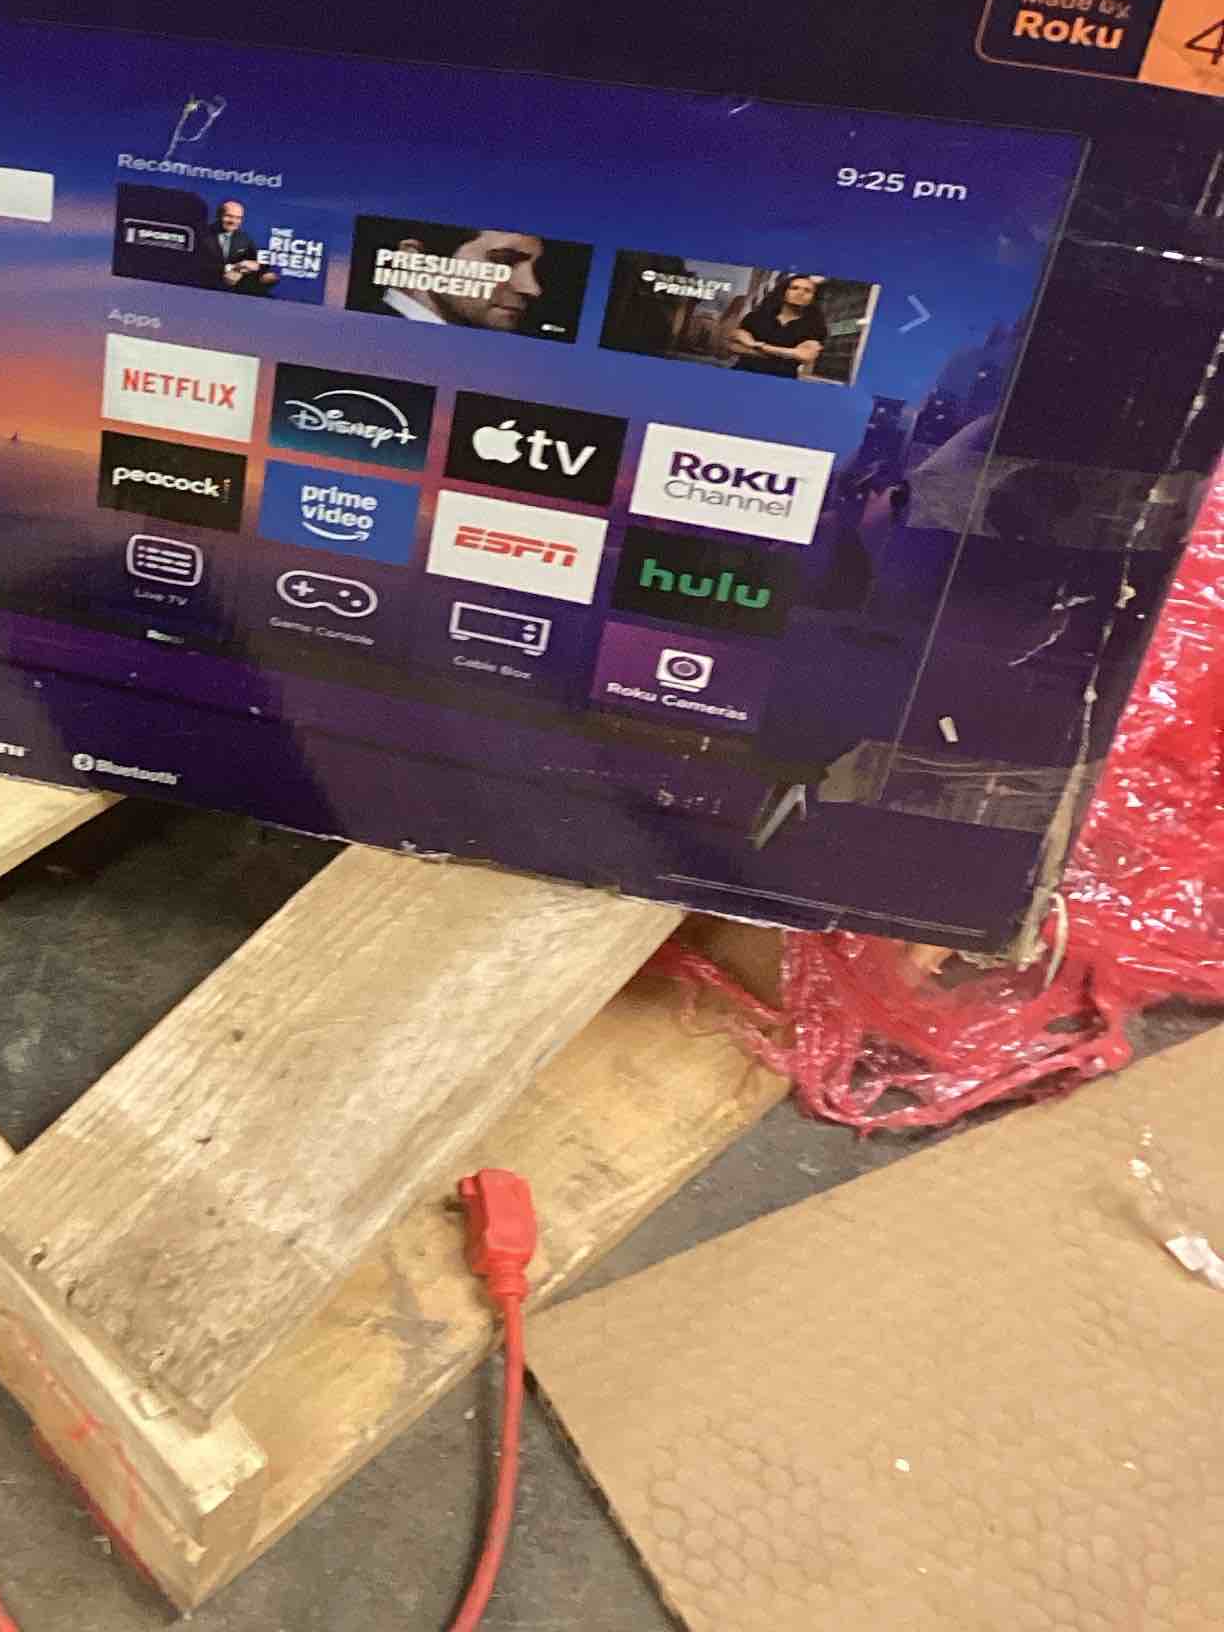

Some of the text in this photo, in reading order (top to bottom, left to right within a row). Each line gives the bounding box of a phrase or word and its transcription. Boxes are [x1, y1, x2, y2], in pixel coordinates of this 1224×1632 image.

[1013, 9, 1124, 49] Roku
[116, 153, 283, 189] Recommended
[836, 166, 969, 201] 9:25 pm
[137, 228, 187, 245] SPORTS
[269, 236, 324, 258] RICH
[256, 249, 322, 273] EISEN
[376, 248, 514, 284] PRESUMED
[373, 268, 499, 301] INNOCENT
[653, 280, 717, 301] PRIME
[108, 308, 162, 329] Apps
[121, 367, 238, 410] NETFLIX
[527, 428, 599, 477] tv
[111, 465, 222, 498] peacock
[668, 450, 798, 497] Roku
[300, 483, 378, 512] prime
[663, 479, 794, 520] Channel
[300, 503, 376, 531] video
[454, 524, 578, 568] ESPN
[639, 558, 772, 610] hulu
[315, 625, 376, 647] Console
[452, 654, 498, 675] Cable
[606, 681, 748, 723] Roku Cameras
[94, 759, 178, 786] Bluetooth
